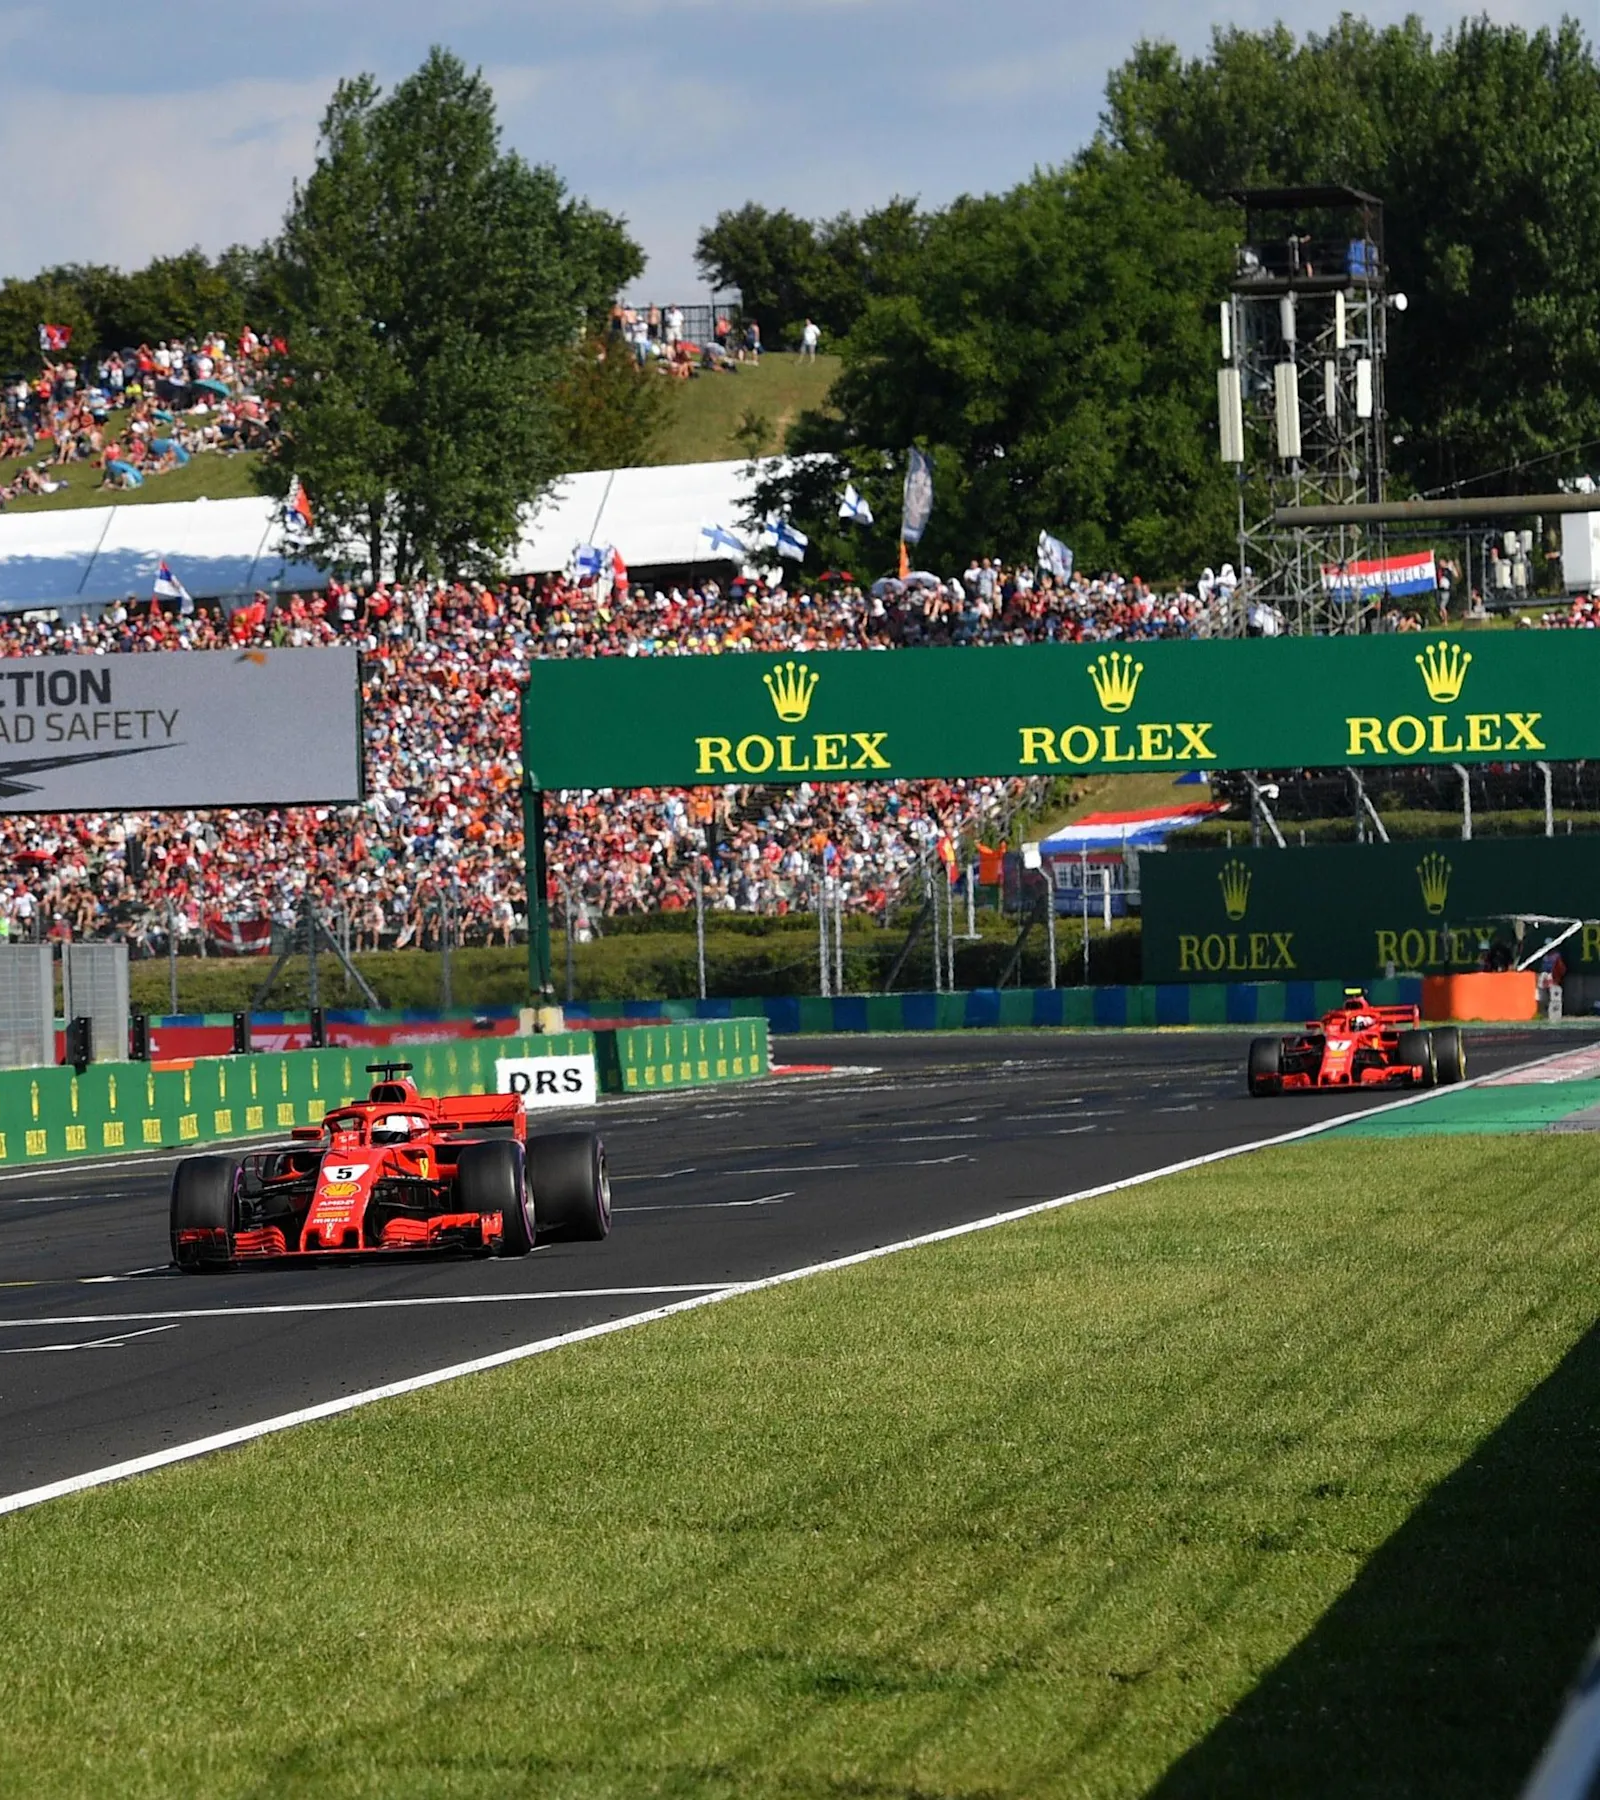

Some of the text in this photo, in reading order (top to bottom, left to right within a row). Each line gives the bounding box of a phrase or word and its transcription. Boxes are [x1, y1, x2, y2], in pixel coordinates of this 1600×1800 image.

[45, 709, 180, 742] SAFETY
[1019, 723, 1216, 764] ROLEX
[1346, 713, 1546, 755] ROLEX
[696, 732, 891, 774] ROLEX
[1180, 932, 1296, 971] ROLEX
[509, 1068, 583, 1094] DRS
[336, 1167, 352, 1180] 5
